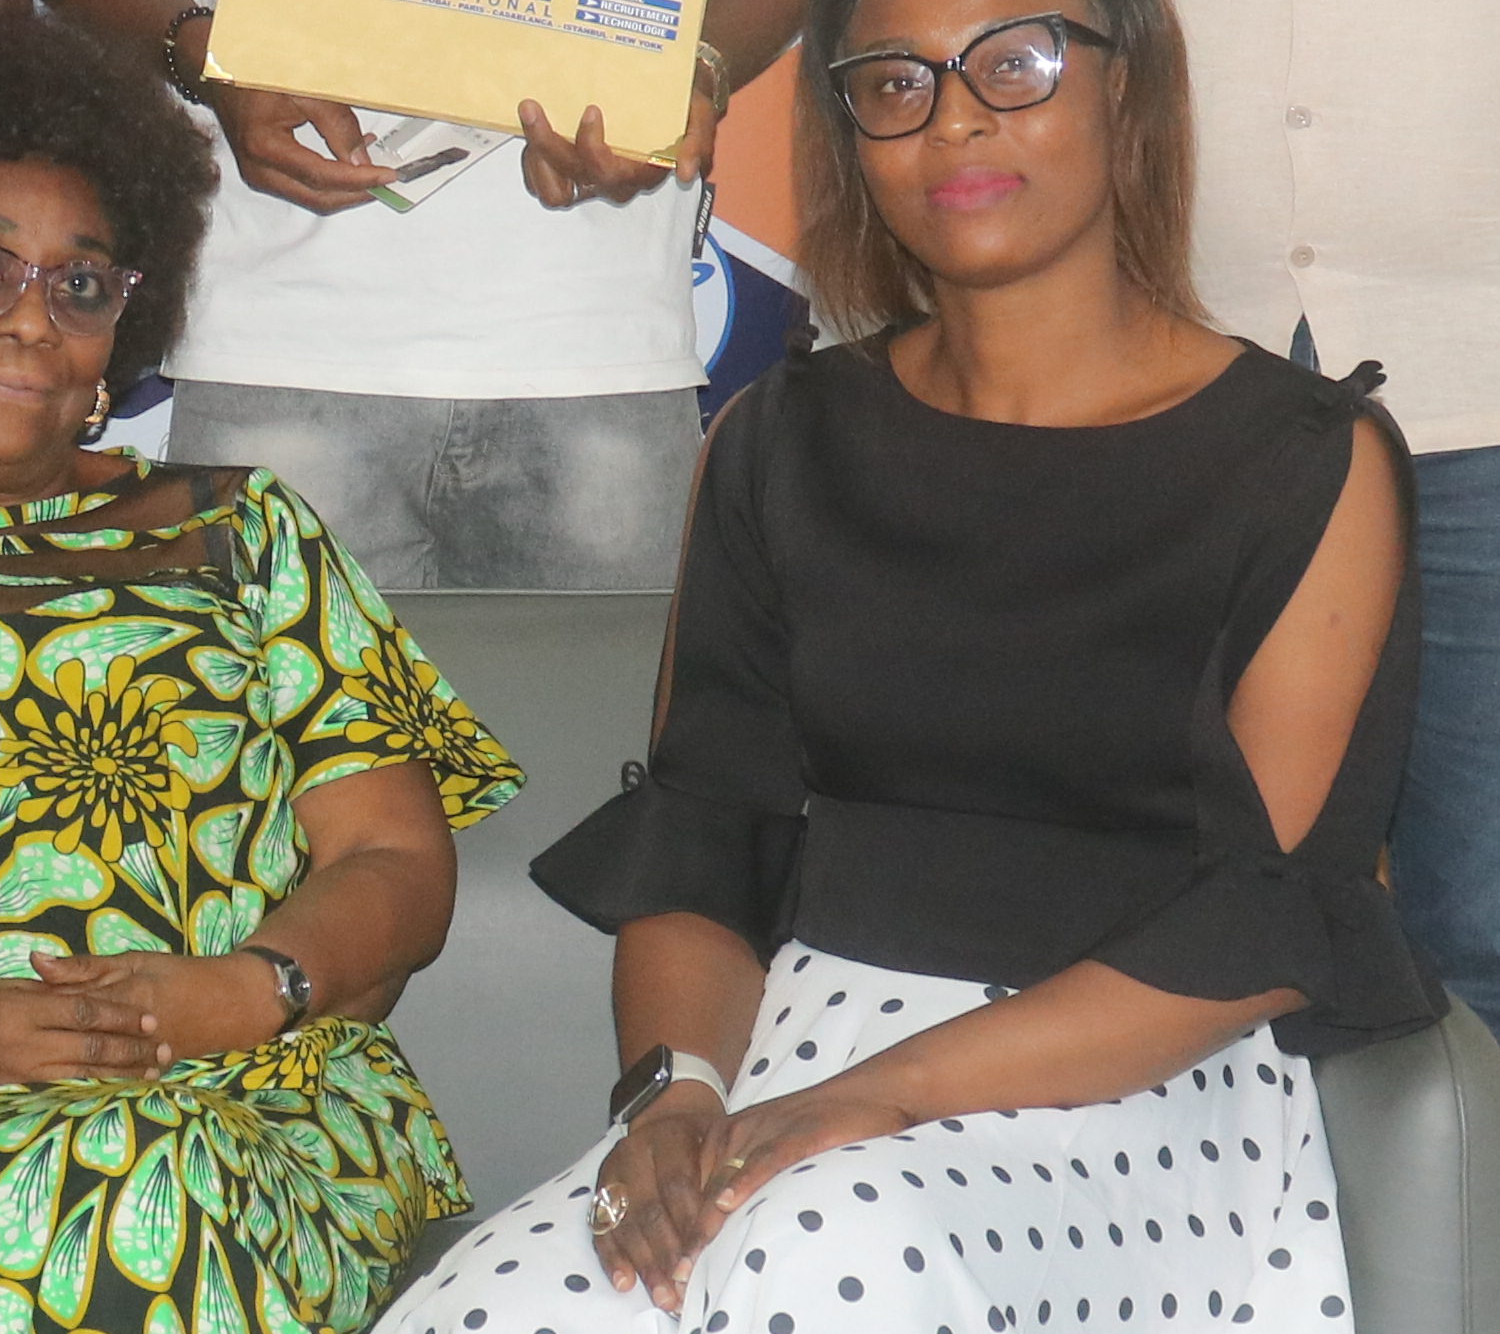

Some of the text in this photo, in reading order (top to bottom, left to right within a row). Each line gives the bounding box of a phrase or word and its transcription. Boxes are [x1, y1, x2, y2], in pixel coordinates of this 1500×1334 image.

[600, 0, 676, 25] RECRUTEMENT
[458, 3, 485, 14] PARIS
[492, 9, 554, 28] CASABLANCA
[563, 24, 608, 39] ISTANBUL
[615, 34, 636, 46] NEW
[639, 40, 664, 51] YORK
[598, 14, 668, 39] TECHNOLOGIE
